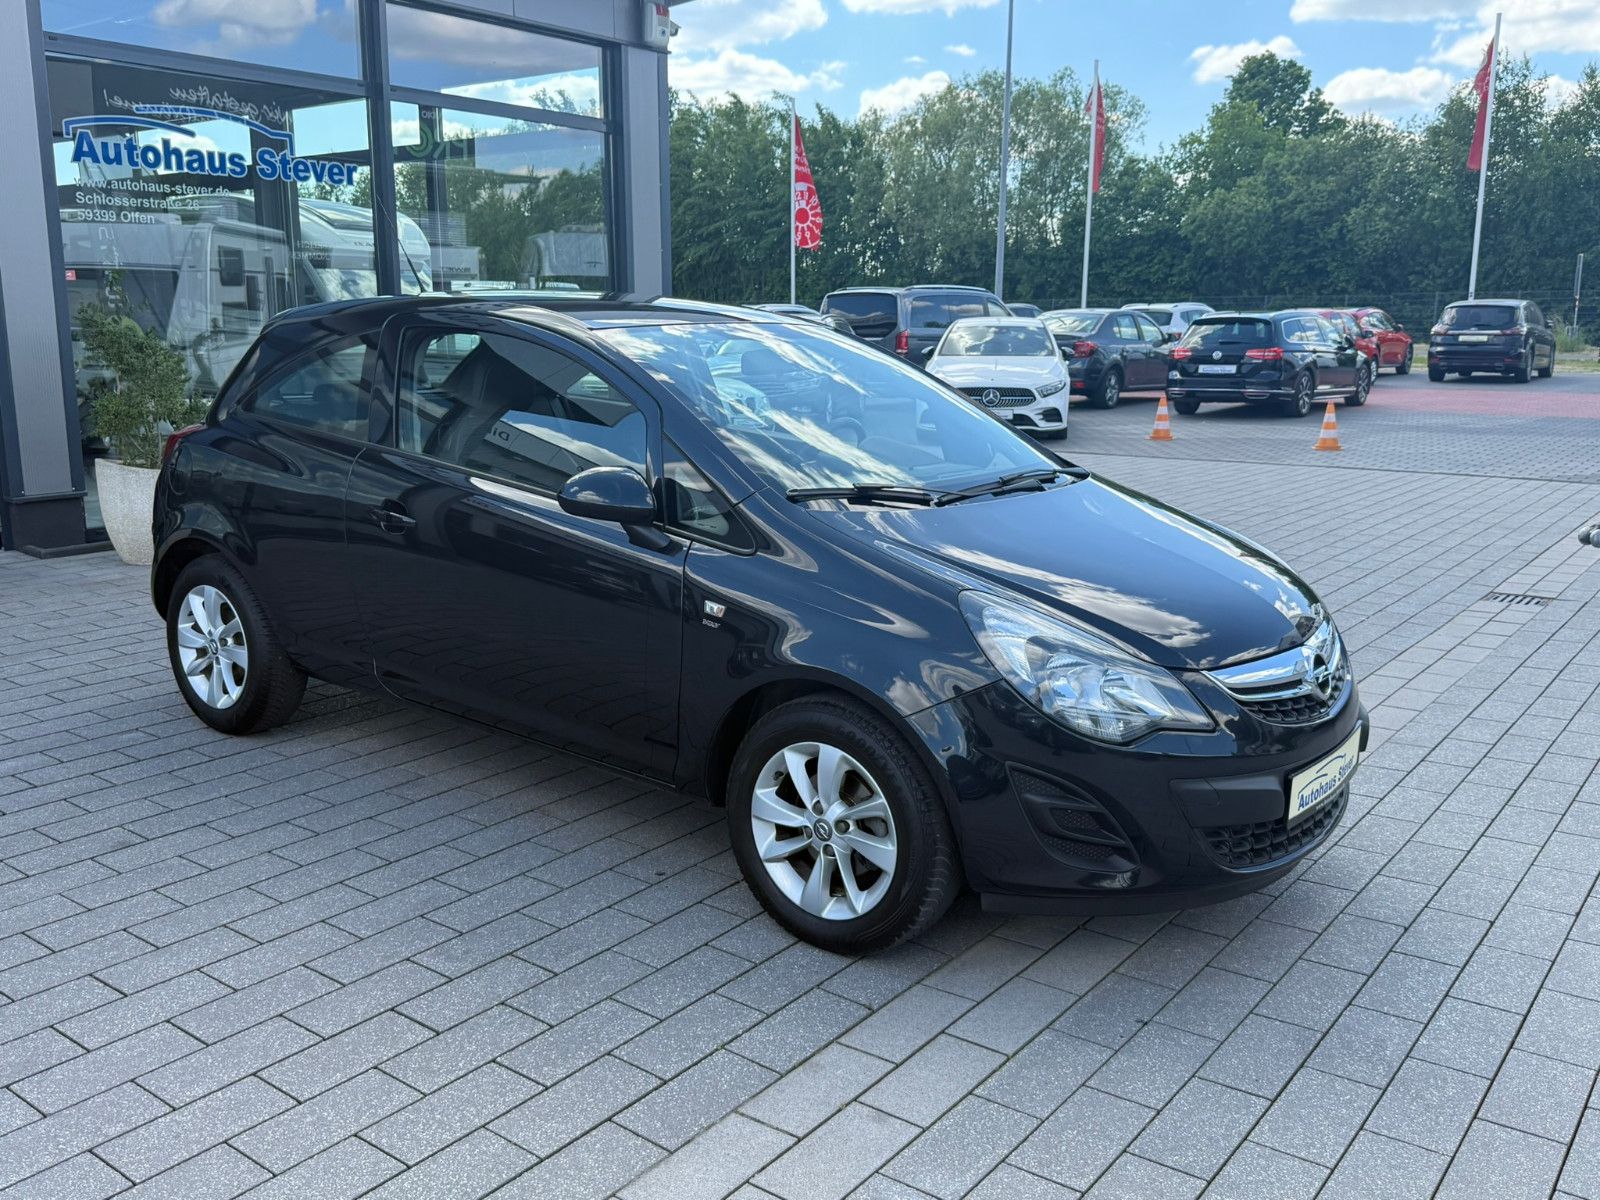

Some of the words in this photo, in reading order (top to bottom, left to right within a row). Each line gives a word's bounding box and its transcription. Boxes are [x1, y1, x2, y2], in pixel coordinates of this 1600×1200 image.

[70, 129, 248, 179] Autohaus
[256, 147, 358, 187] Stever
[74, 178, 230, 196] www.autohaus-stever.de
[78, 208, 116, 222] 59399
[120, 210, 155, 224] Olfen
[1297, 775, 1337, 811] Autohaus
